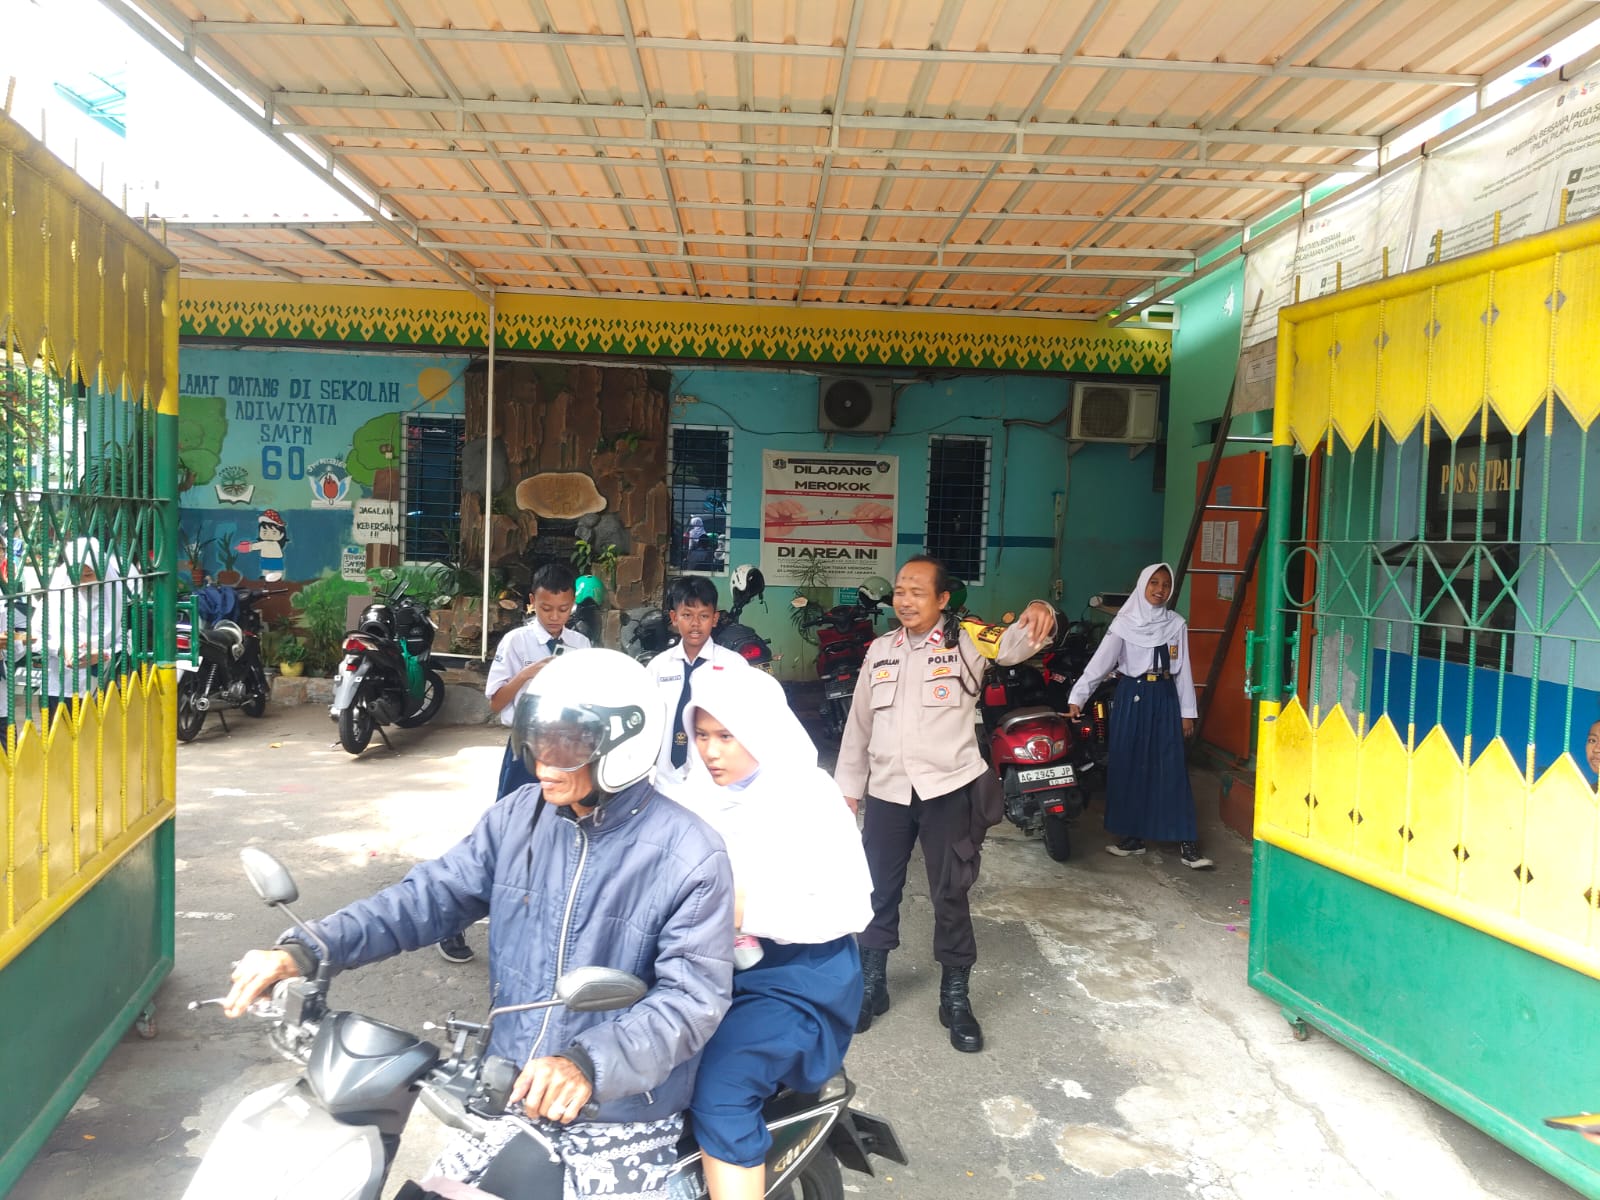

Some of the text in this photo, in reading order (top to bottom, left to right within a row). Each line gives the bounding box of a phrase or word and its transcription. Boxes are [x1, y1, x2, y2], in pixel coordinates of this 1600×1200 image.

[1570, 107, 1593, 123] JAGA
[228, 376, 279, 398] DATANG
[290, 378, 311, 399] DI
[320, 380, 400, 403] SEKOLAH
[235, 401, 336, 425] ADIWIYATA
[260, 424, 313, 444] SMPN
[262, 446, 305, 480] 60
[793, 465, 873, 476] DILARANG
[1468, 457, 1521, 494] STPAM
[794, 481, 871, 492] MEROKOK
[777, 546, 878, 560] DI AREA INI
[928, 655, 958, 664] POLRI
[1021, 767, 1071, 782] AG 2945 JP
